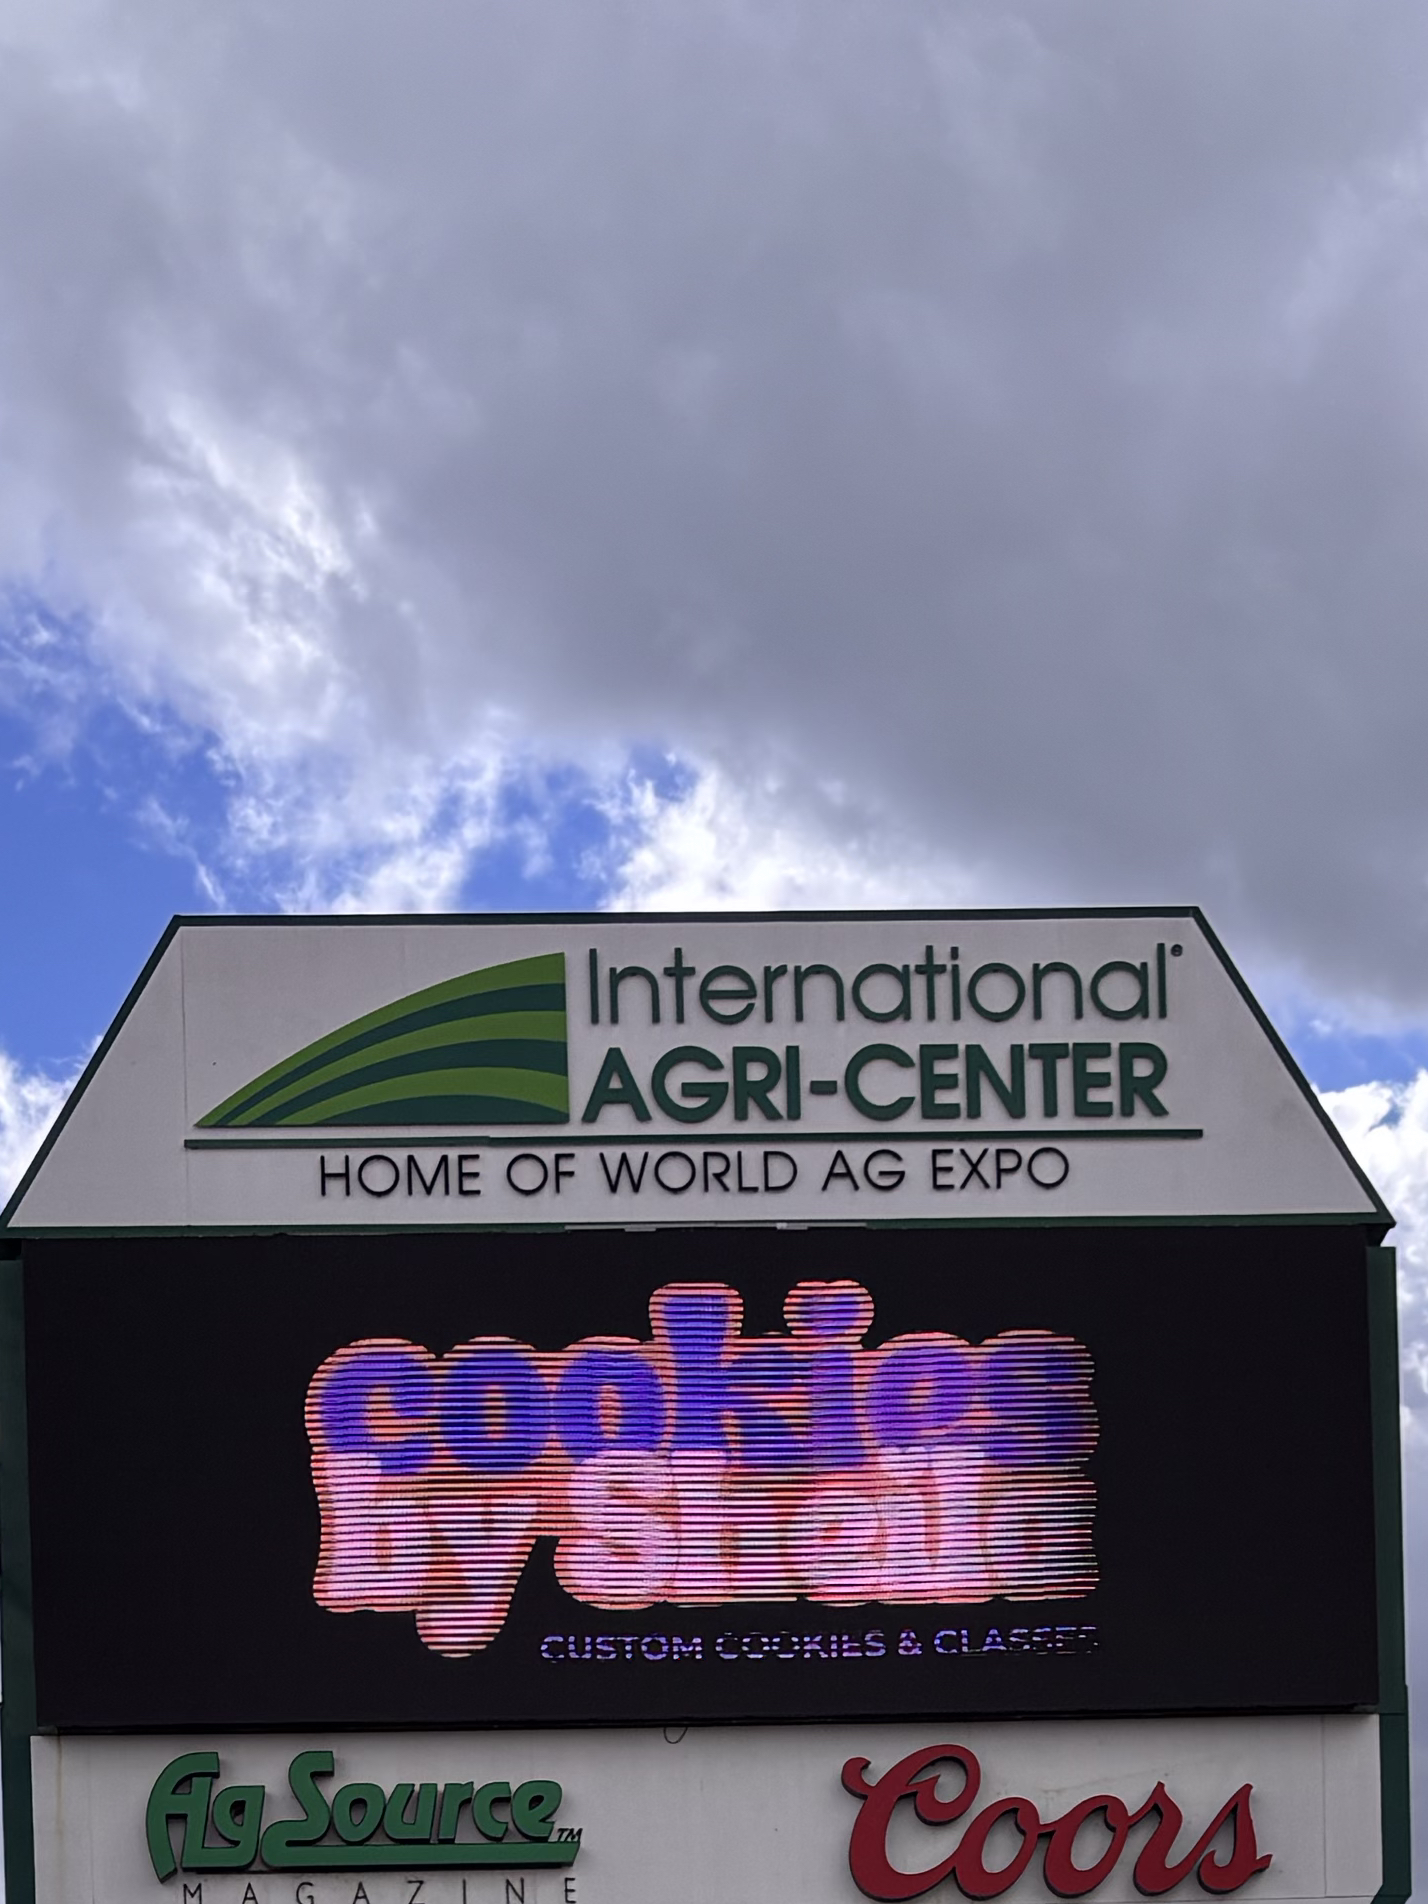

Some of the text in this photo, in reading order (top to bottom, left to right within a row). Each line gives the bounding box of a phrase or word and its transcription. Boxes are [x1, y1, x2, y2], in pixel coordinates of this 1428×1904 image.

[588, 942, 1167, 1025] International
[580, 1042, 1170, 1124] AGRI-CENTER
[318, 1146, 1071, 1198] HOME OF WORLD AG EXPO
[314, 1287, 1096, 1474] cookies
[540, 1634, 703, 1662] CUSTOM
[715, 1631, 887, 1660] COOKIES
[897, 1629, 922, 1656] &
[146, 1750, 575, 1884] AgSource
[840, 1743, 1273, 1902] Coors
